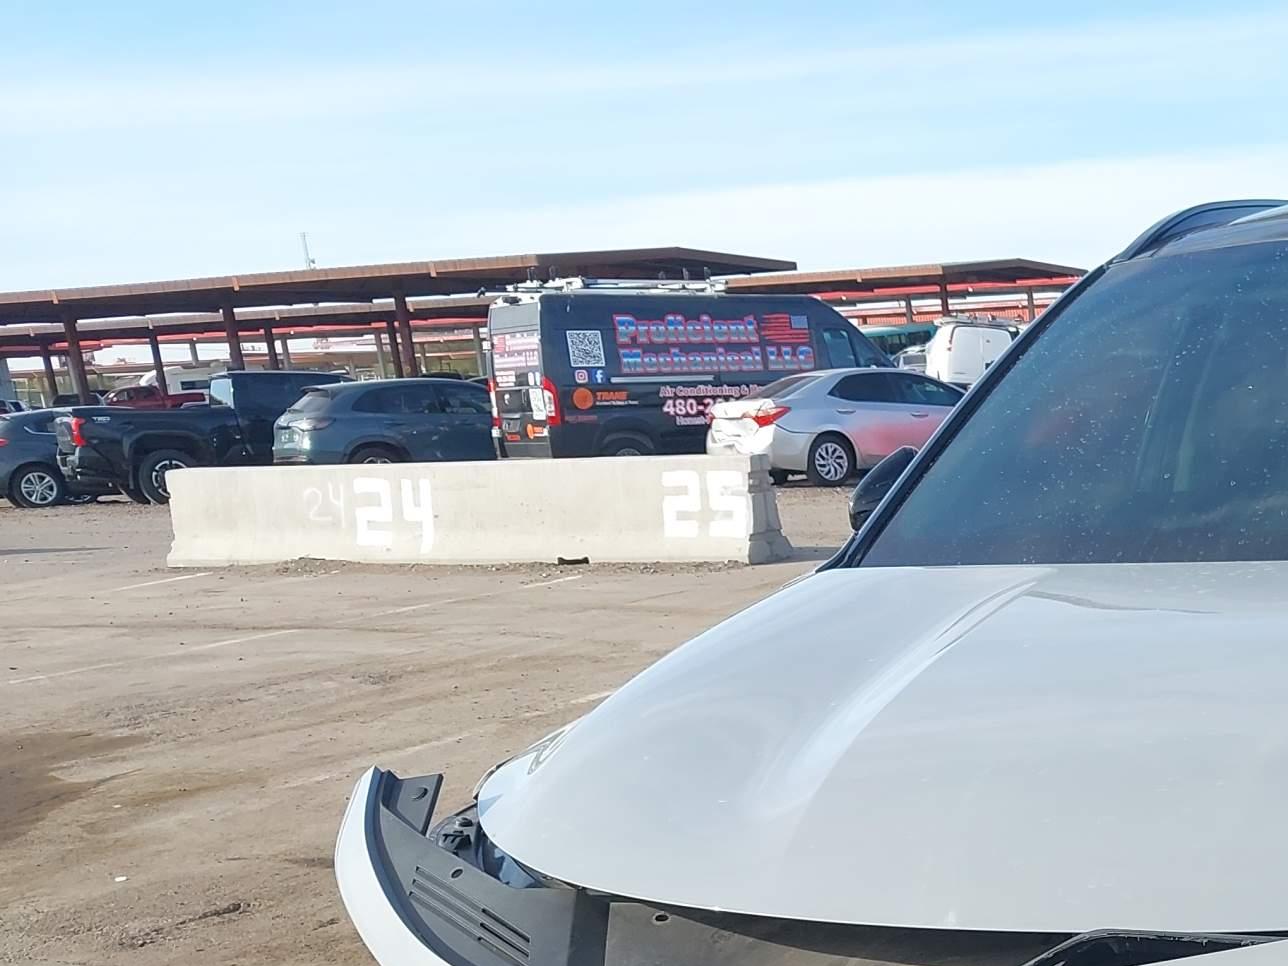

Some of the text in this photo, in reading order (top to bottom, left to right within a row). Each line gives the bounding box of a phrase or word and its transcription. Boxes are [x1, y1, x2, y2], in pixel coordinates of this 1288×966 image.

[613, 314, 760, 344] Proficient
[618, 346, 816, 373] Mechanical LLC
[659, 385, 676, 397] Air
[675, 384, 740, 397] Conditioning
[302, 470, 749, 555] 24 24 25
